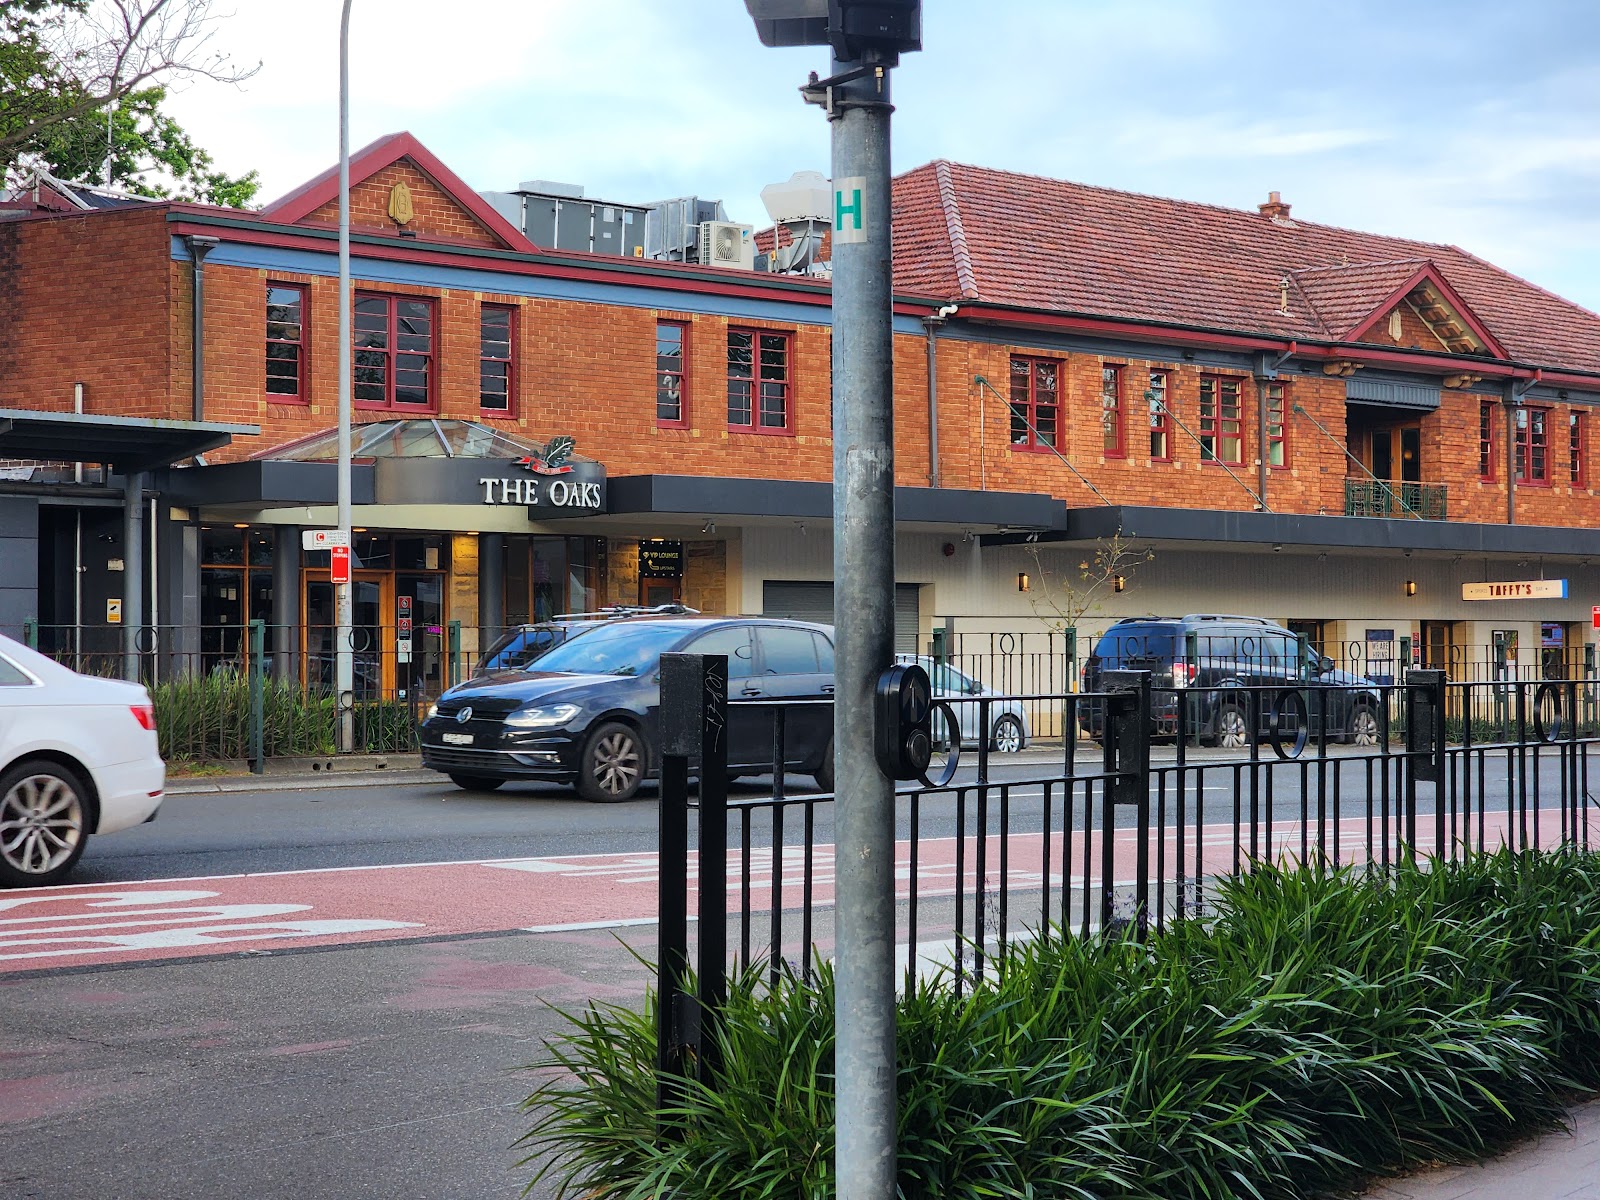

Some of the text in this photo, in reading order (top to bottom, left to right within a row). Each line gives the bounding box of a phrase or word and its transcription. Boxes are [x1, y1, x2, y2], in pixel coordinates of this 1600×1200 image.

[836, 189, 862, 231] H
[480, 478, 601, 508] THE OAKS
[1489, 584, 1532, 596] TAFFY'S
[1380, 642, 1389, 650] ARE
